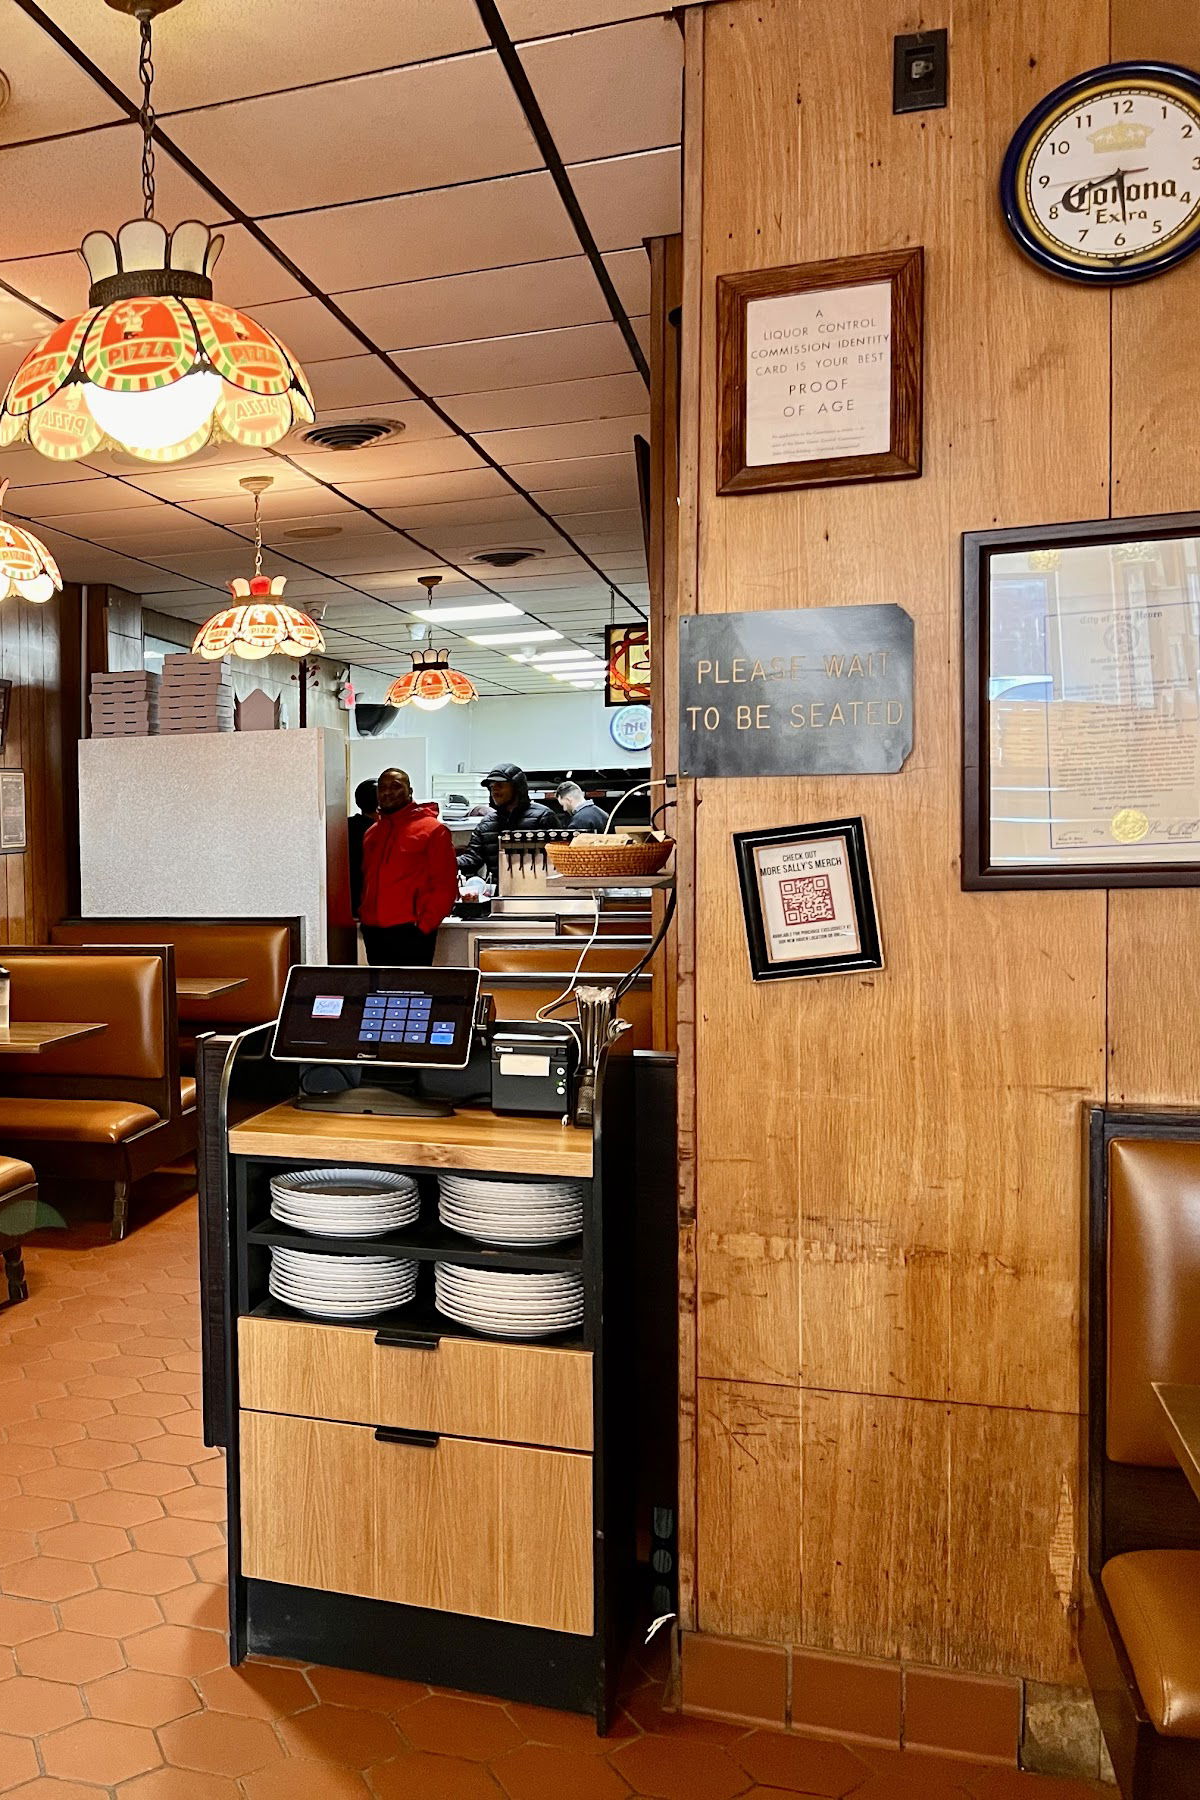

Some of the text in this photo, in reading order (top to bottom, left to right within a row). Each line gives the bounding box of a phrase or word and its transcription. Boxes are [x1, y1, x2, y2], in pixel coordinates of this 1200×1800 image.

[1113, 100, 1134, 115] 12
[1161, 106, 1168, 119] 1
[1075, 115, 1092, 128] 11
[1180, 124, 1193, 139] 2
[1049, 141, 1070, 155] 10
[1038, 175, 1050, 189] 9
[1179, 191, 1191, 204] 4
[1049, 206, 1059, 220] 8
[1096, 209, 1147, 225] Exra
[1152, 220, 1163, 234] 5
[1078, 229, 1089, 242] 7
[1114, 232, 1126, 246] 6
[815, 309, 824, 318] A
[763, 318, 877, 341] LIQUOR CONTROL
[751, 333, 890, 359] COMMISSION IDENTITY
[107, 341, 177, 368] PIZZA
[755, 352, 884, 377] CARD IS YOUR BEST
[789, 378, 849, 395] PROOF
[783, 399, 855, 418] OF AGE
[697, 651, 891, 685] PLEASE WAIT
[686, 700, 904, 731] TO BE SEATED
[782, 850, 817, 862] CHECK OUT
[760, 857, 842, 877] MORE SALLY'S MERCH
